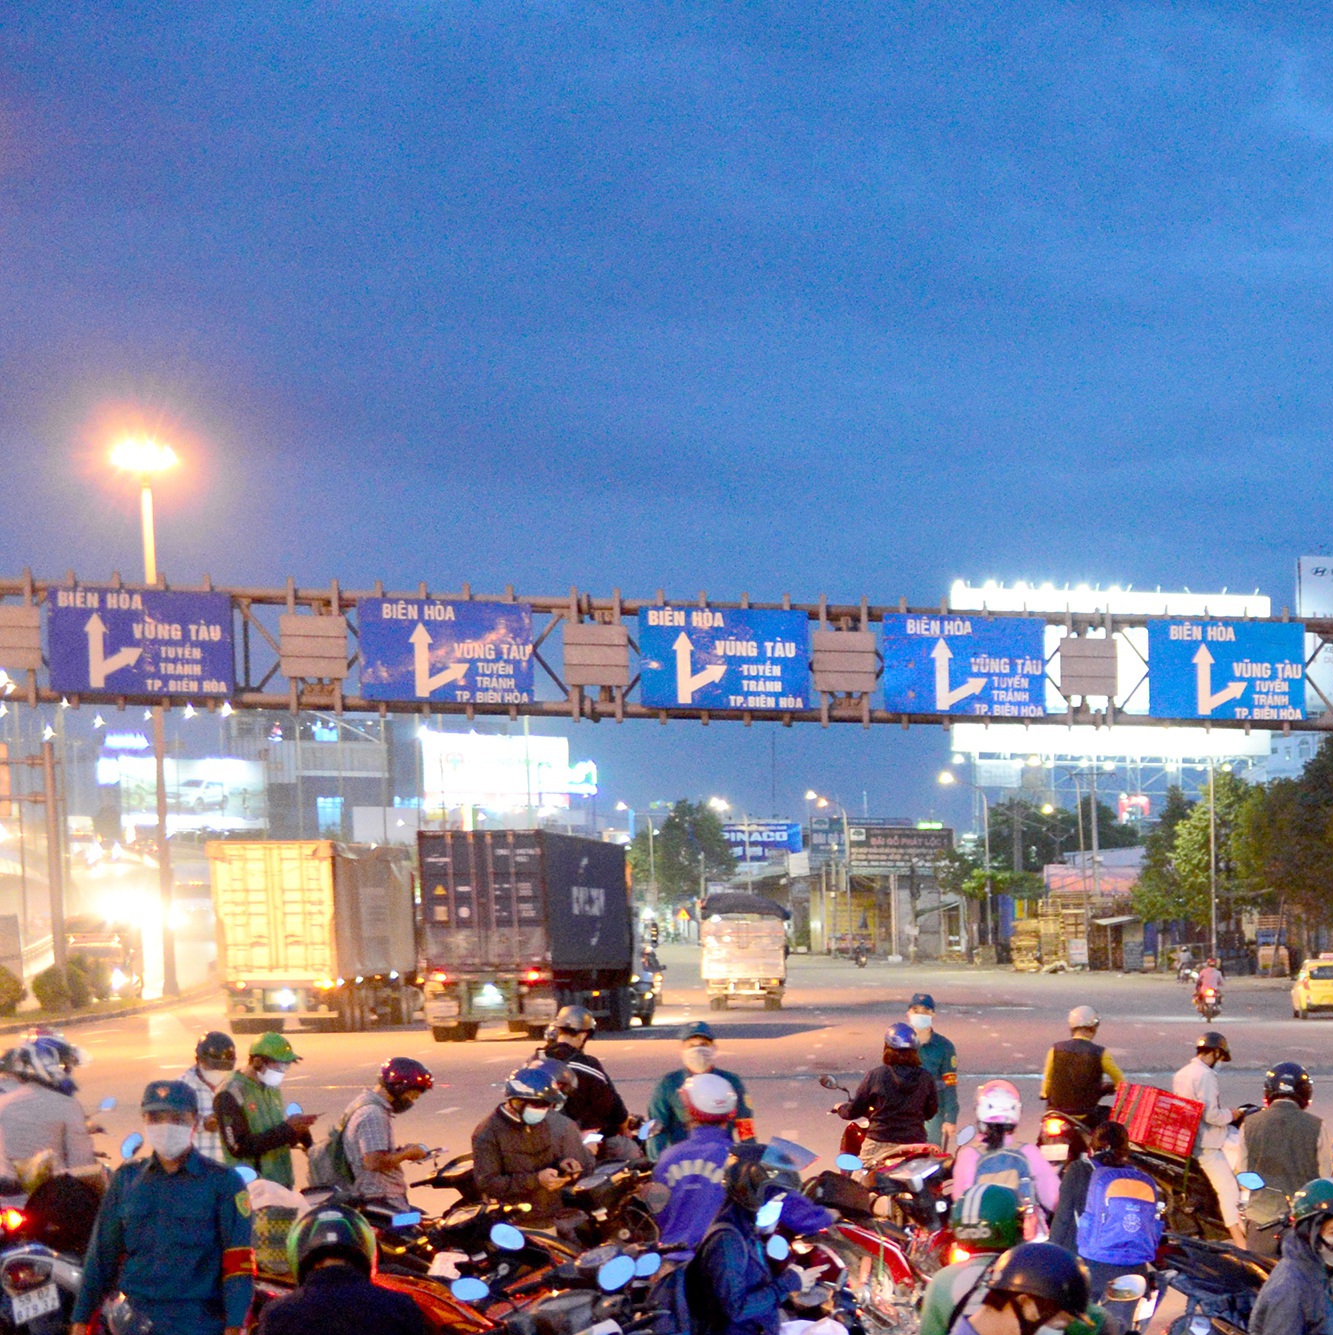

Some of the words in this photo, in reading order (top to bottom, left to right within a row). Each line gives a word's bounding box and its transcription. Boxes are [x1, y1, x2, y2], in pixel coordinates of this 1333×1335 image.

[57, 588, 99, 608] BIÊN
[106, 590, 143, 610] HÒA
[382, 601, 418, 620] BIÊN
[424, 600, 455, 620] HÒA
[648, 607, 686, 626] BIÊN
[692, 608, 724, 627] HÒA
[188, 620, 221, 641] TÀU
[906, 616, 940, 635] BIÊN
[944, 617, 972, 635] HÒA
[1169, 622, 1203, 641] BIÊN
[1207, 622, 1235, 641] HÒA
[715, 636, 758, 656] VŨNG
[764, 637, 796, 657] TÀU
[970, 654, 1010, 673] VŨNG
[1016, 655, 1042, 674] TÀU
[1233, 659, 1271, 678] VŨNG
[1275, 659, 1302, 679] TÀU
[504, 690, 528, 703] HÒA
[1021, 703, 1044, 717] HÒA
[1279, 706, 1302, 720] HÒA
